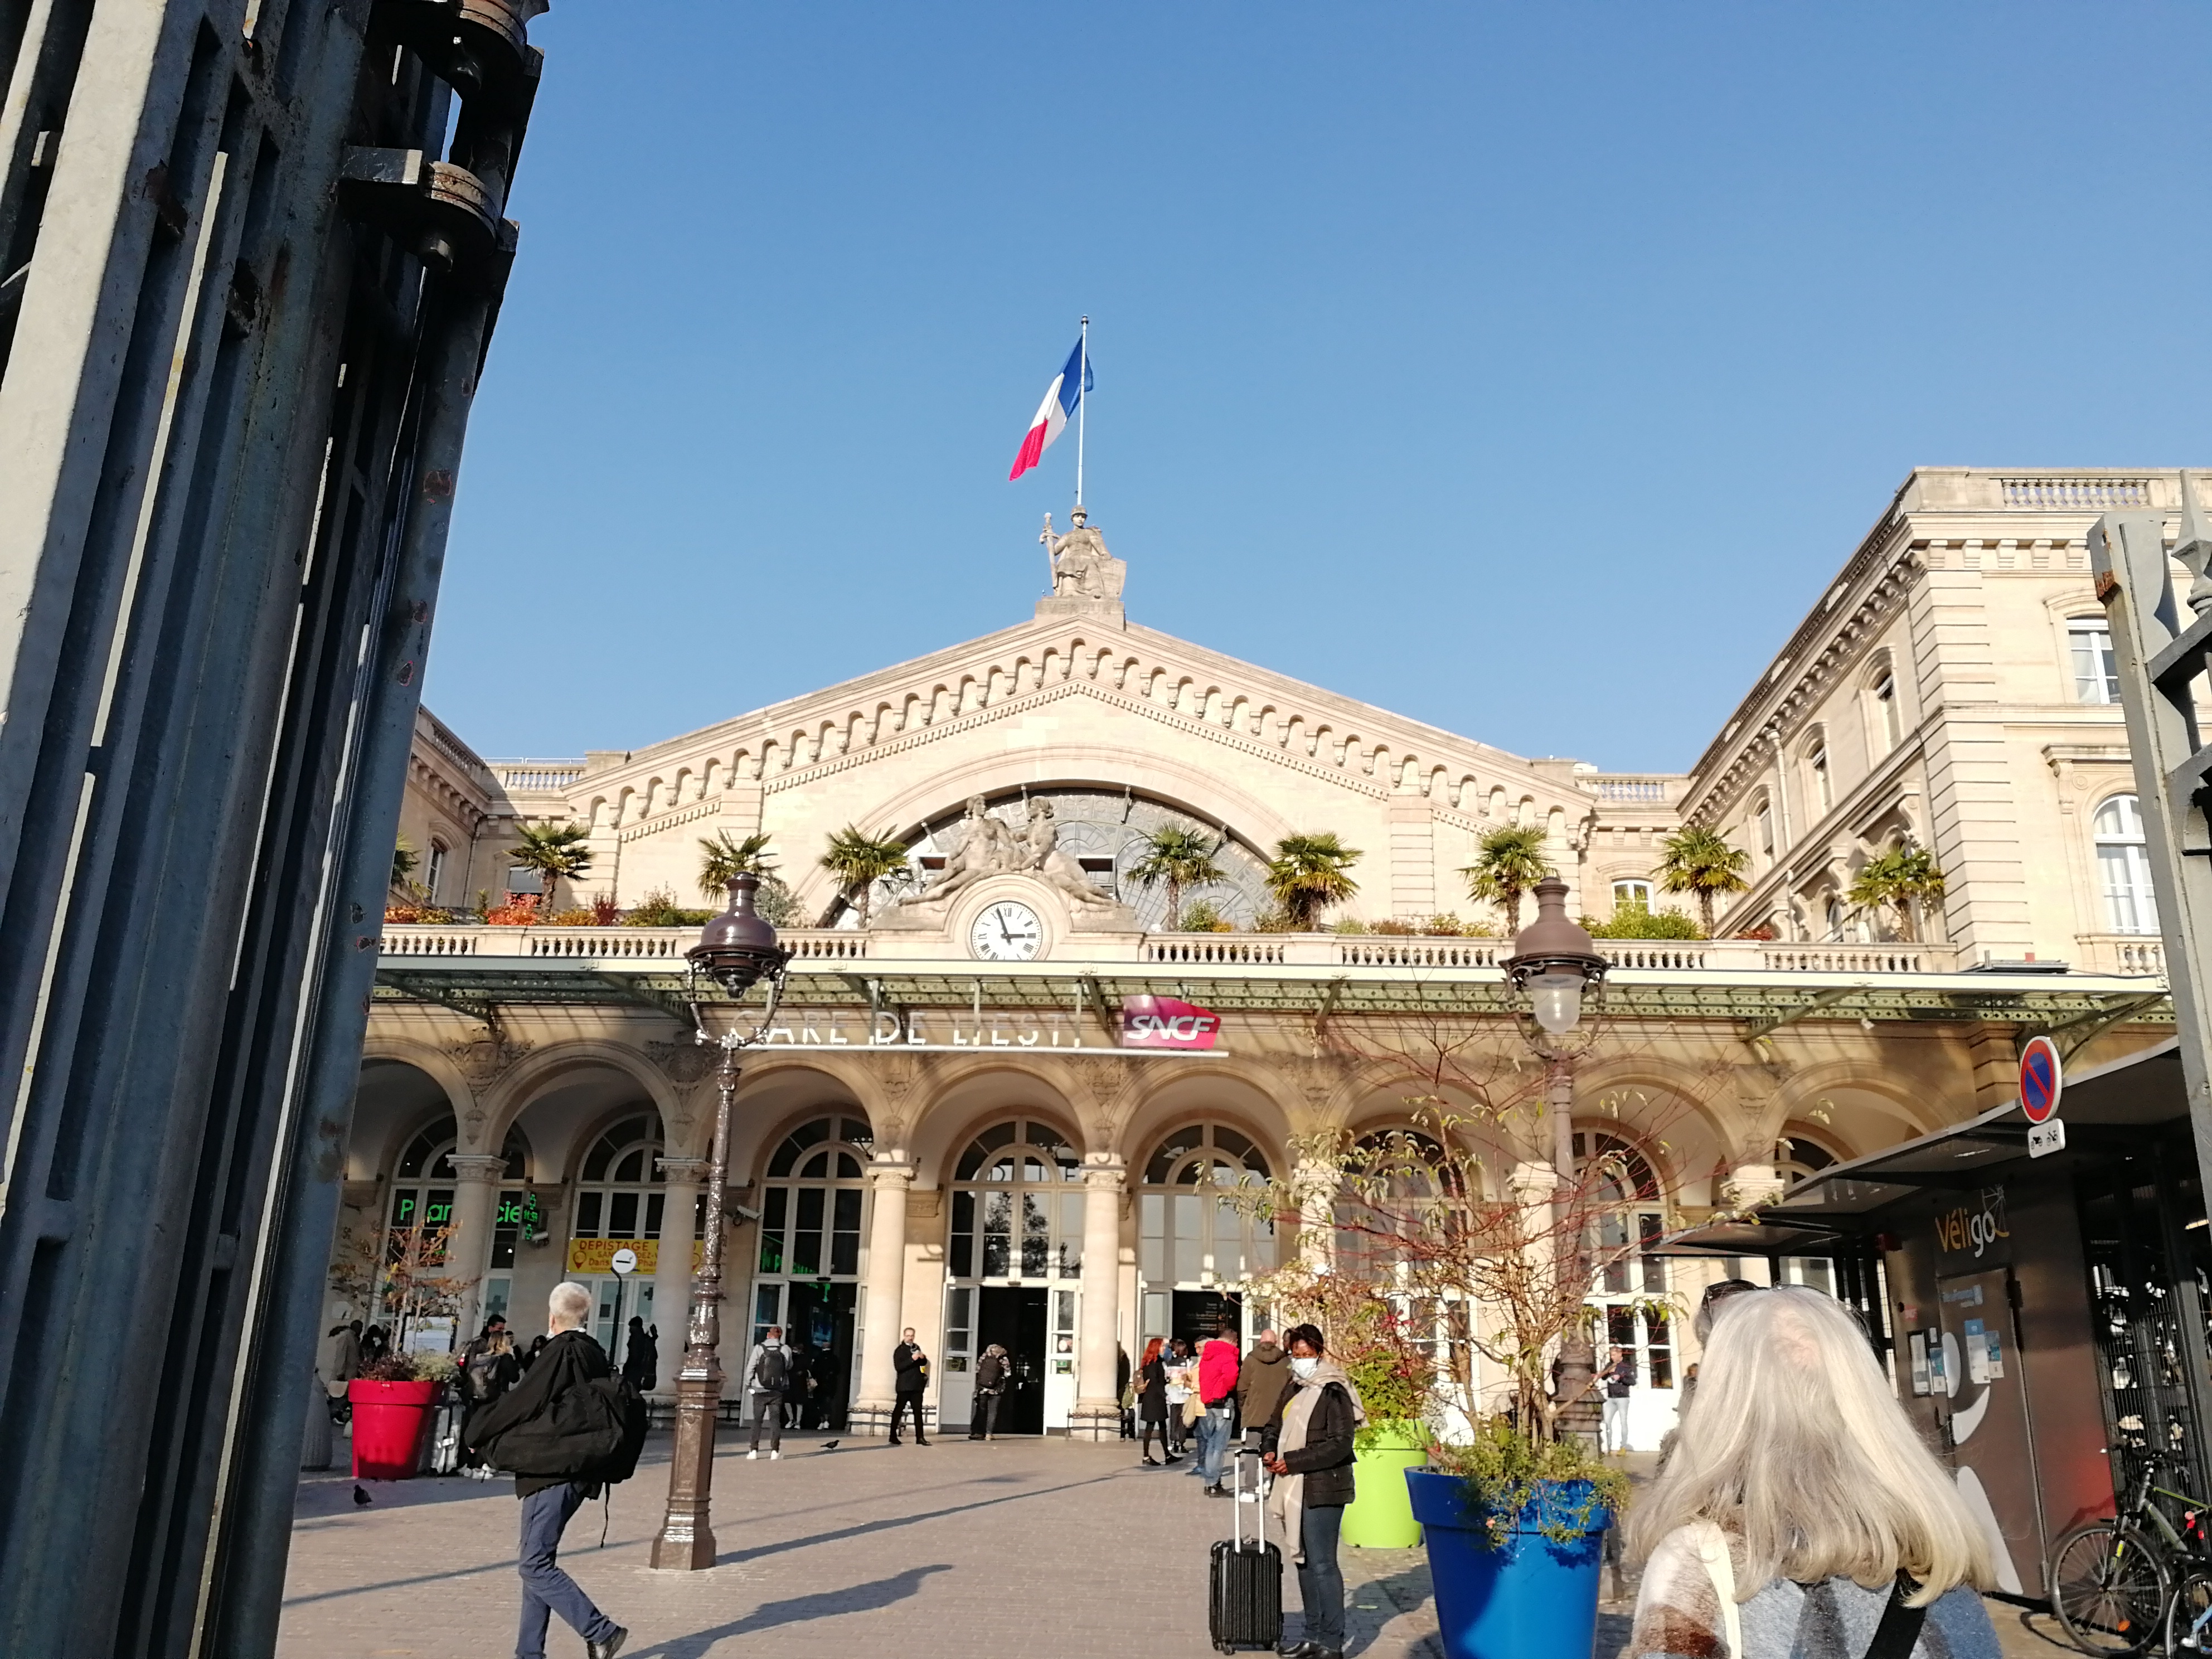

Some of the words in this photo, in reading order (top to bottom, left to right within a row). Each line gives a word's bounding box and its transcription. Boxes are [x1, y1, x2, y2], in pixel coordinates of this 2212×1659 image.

[730, 1011, 848, 1043] GARE
[875, 1011, 926, 1044] DE
[1127, 1015, 1215, 1041] SNCF
[579, 1240, 649, 1251] DEPISTAGE
[1935, 1207, 1997, 1258] Véligo
